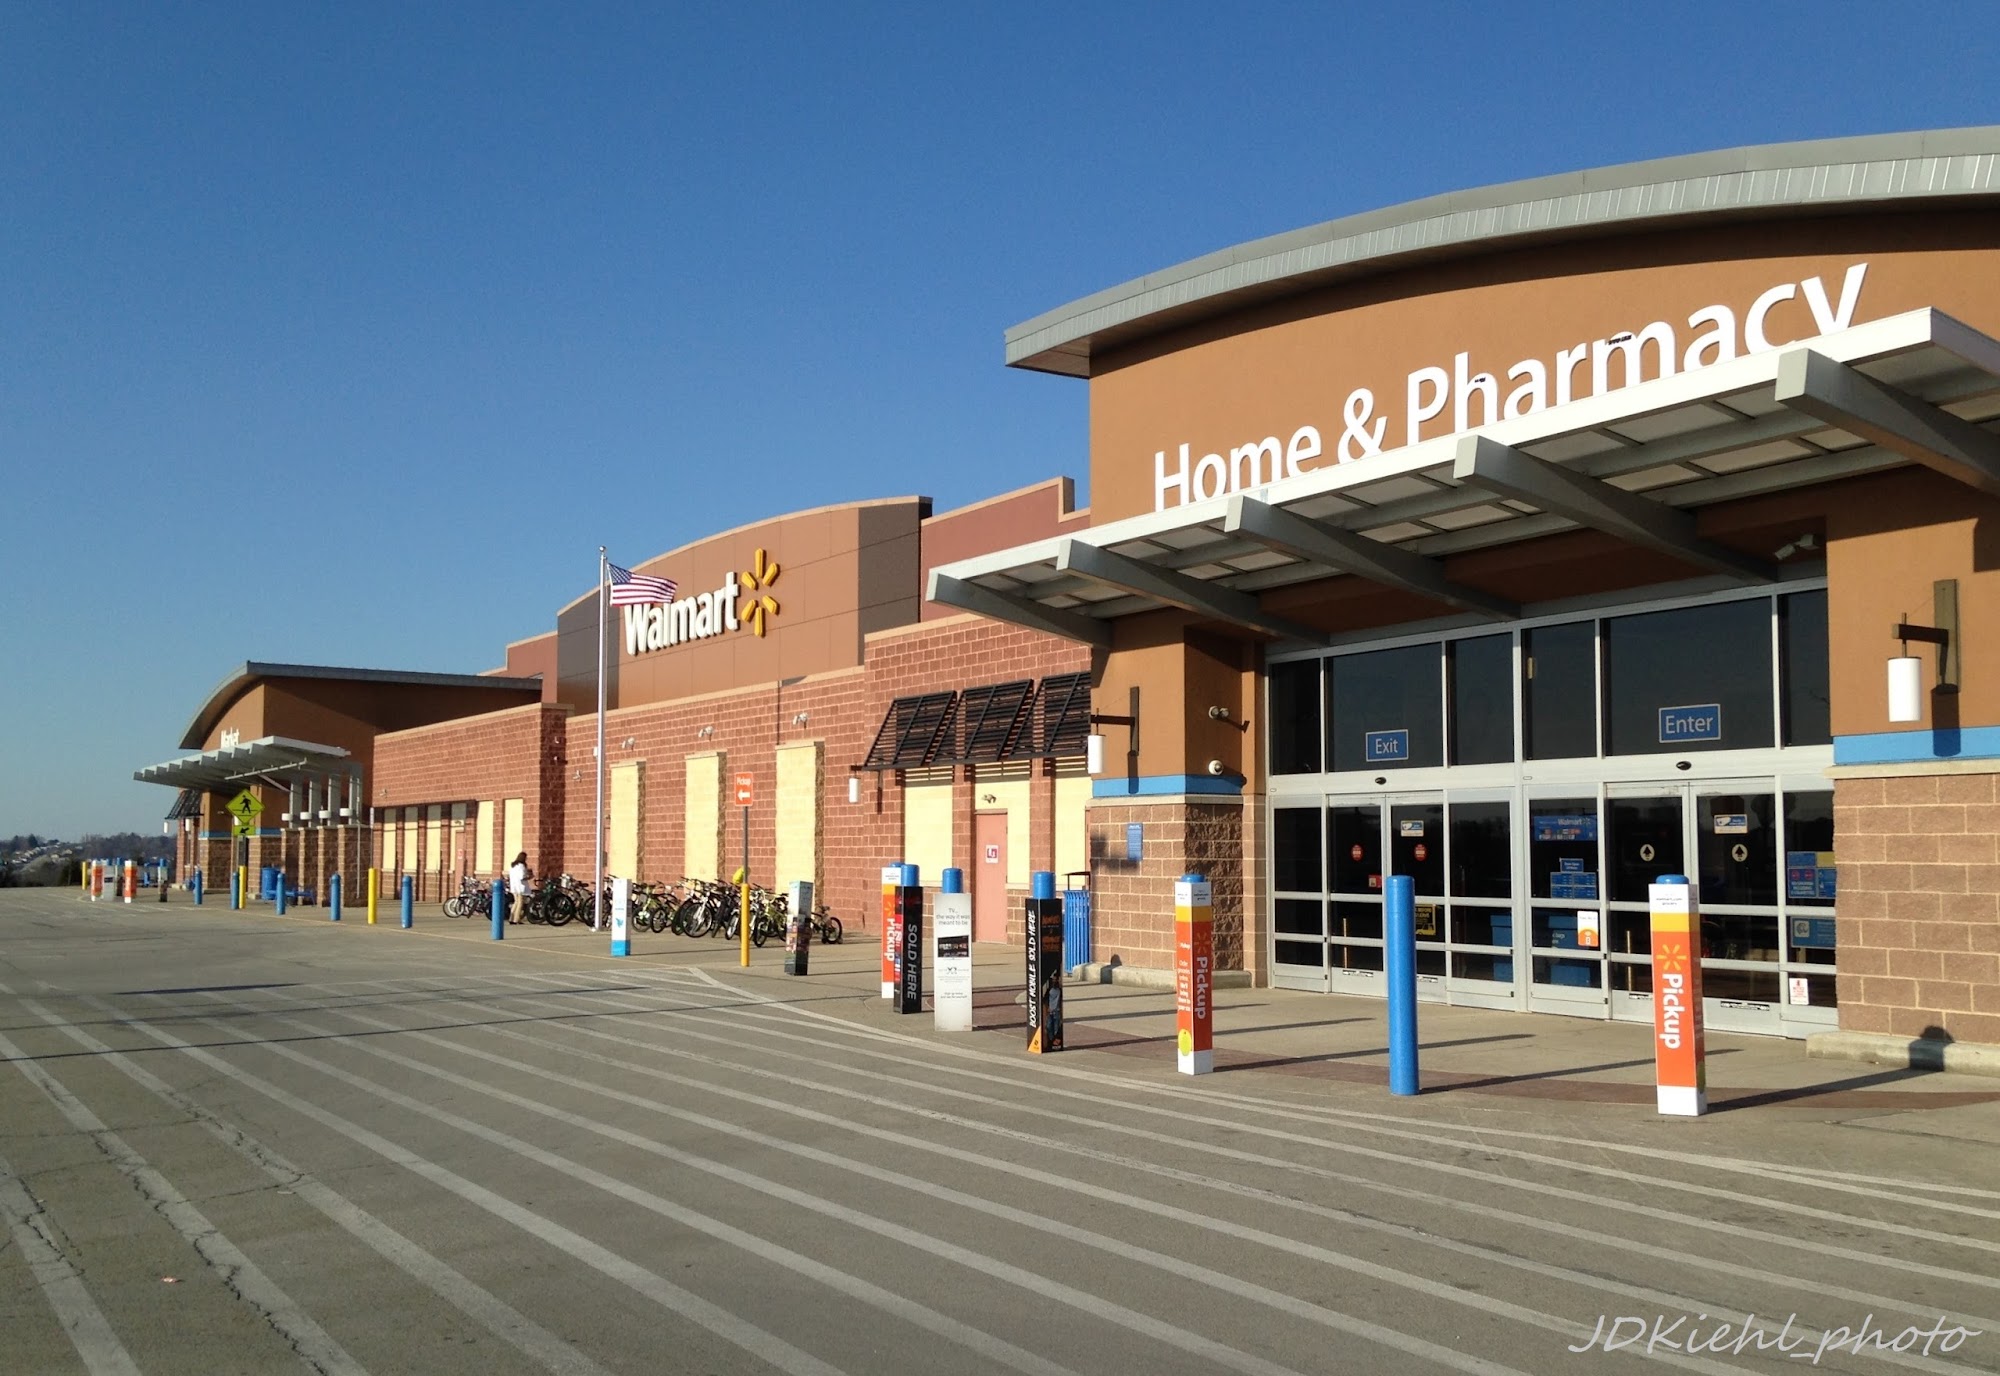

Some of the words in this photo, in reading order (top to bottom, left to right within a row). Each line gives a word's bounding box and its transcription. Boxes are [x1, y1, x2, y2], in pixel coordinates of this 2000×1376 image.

[1154, 425, 1321, 513] Home
[1337, 386, 1387, 465] &
[1406, 263, 1868, 442] Pharmacy
[624, 571, 740, 656] Walmart
[1665, 714, 1713, 734] Enter
[1375, 738, 1398, 755] Exit
[1028, 910, 1036, 937] HERE
[908, 924, 918, 960] SOLD
[1028, 937, 1036, 961] SOLD
[907, 963, 917, 1000] HERE
[1028, 964, 1037, 997] MOBILE
[1194, 957, 1209, 1020] Pickup
[1659, 973, 1686, 1049] Pickup
